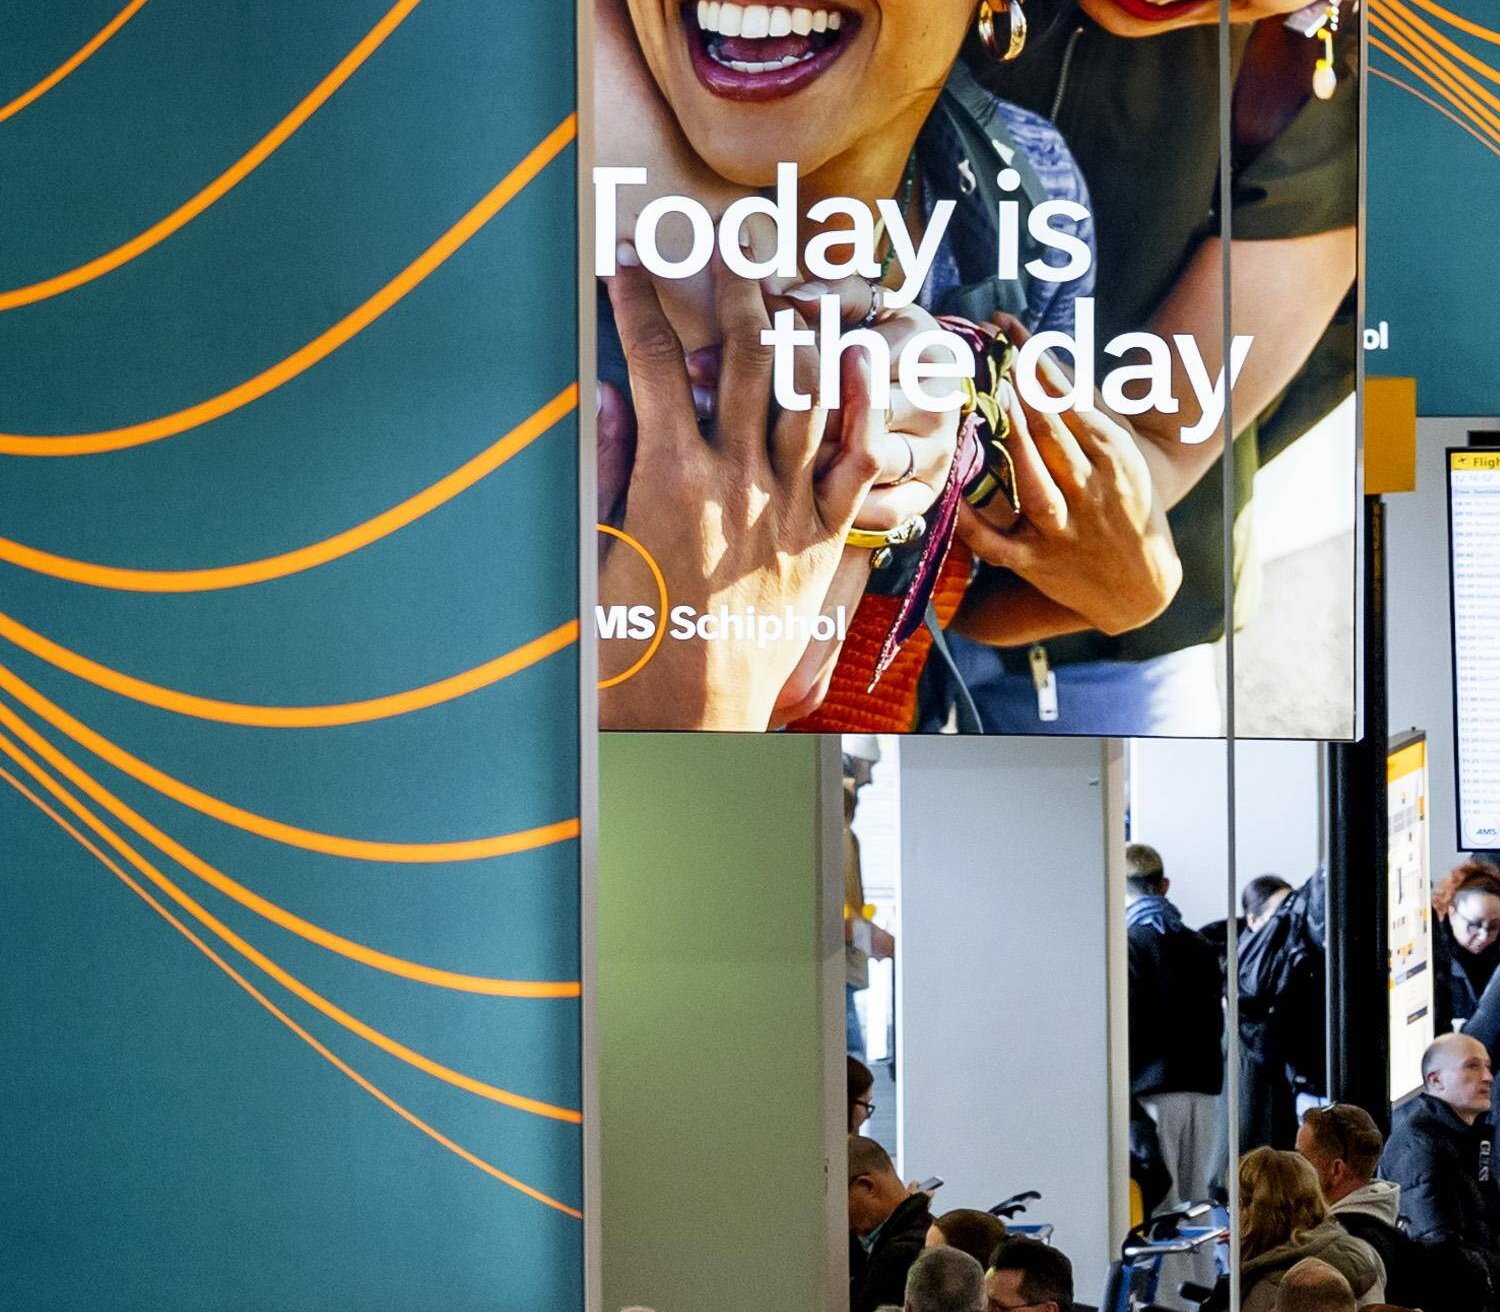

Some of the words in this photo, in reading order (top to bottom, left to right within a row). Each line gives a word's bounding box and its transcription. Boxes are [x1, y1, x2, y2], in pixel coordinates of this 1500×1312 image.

[593, 162, 953, 301] Today
[996, 168, 1092, 281] is
[760, 295, 977, 413] the
[1014, 295, 1255, 444] day
[670, 604, 847, 648] Schiphol
